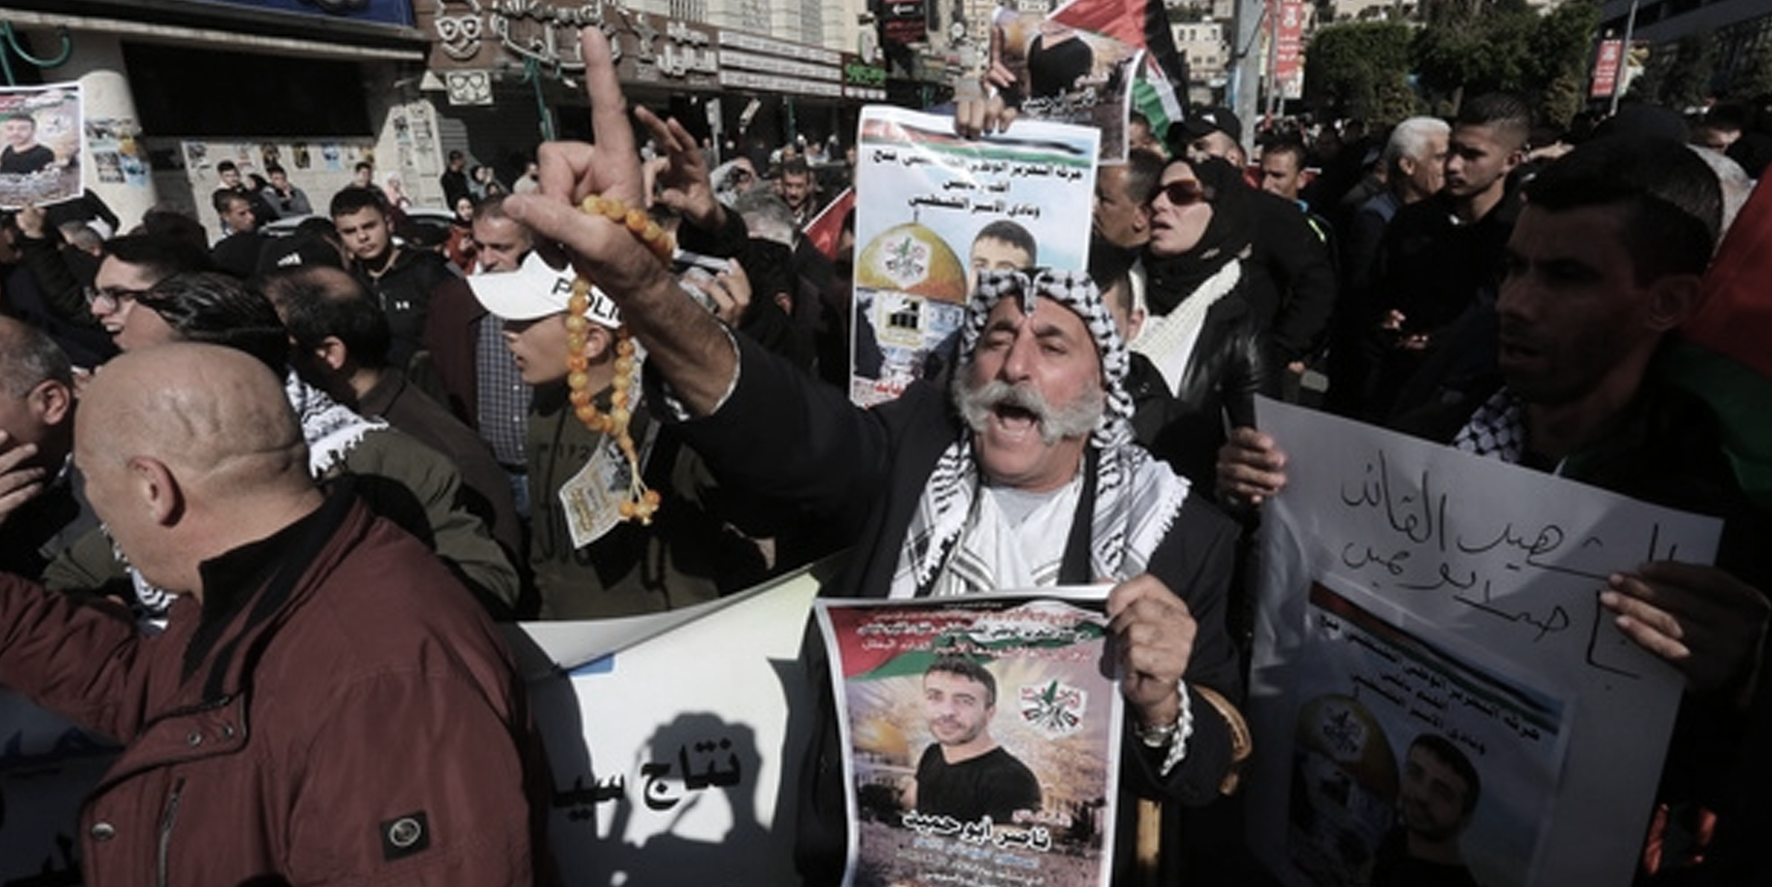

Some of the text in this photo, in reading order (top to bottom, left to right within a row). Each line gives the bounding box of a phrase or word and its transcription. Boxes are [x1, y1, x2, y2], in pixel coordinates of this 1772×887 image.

[640, 737, 741, 811] نتاج
[902, 809, 962, 835] حميد
[995, 825, 1051, 850] ناصر
